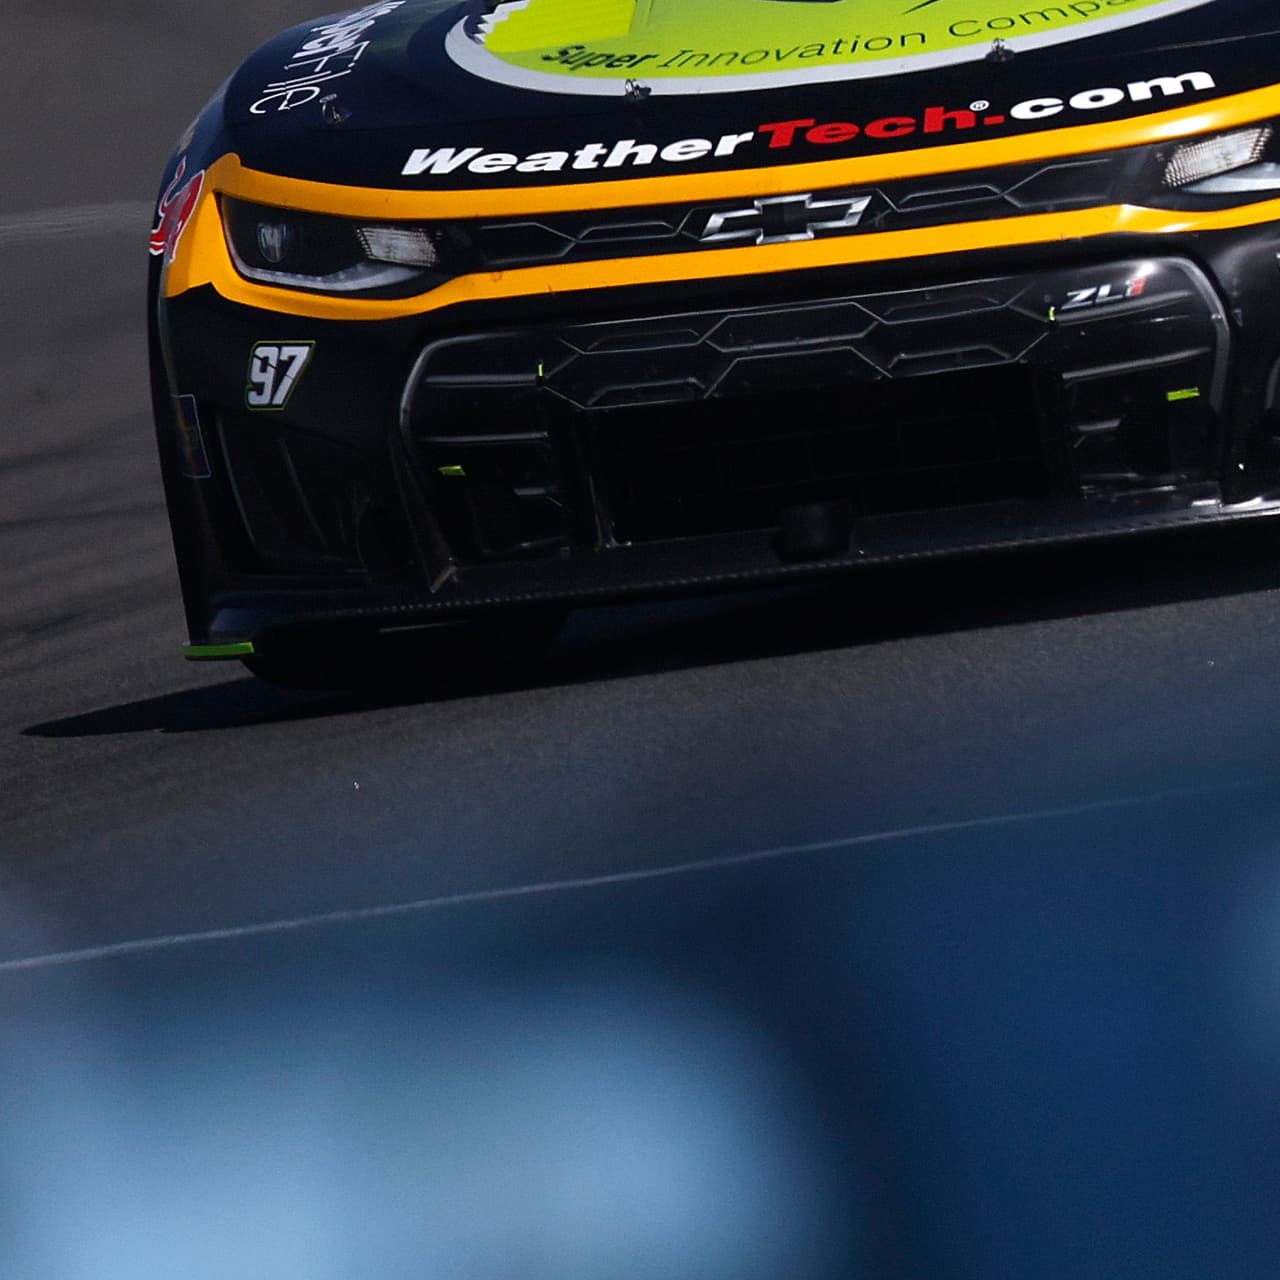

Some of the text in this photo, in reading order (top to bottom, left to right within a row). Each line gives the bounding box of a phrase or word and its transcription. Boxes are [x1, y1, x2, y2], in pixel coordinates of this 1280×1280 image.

[540, 43, 657, 71] Super
[657, 28, 926, 68] Innovation
[248, 346, 310, 405] 97
